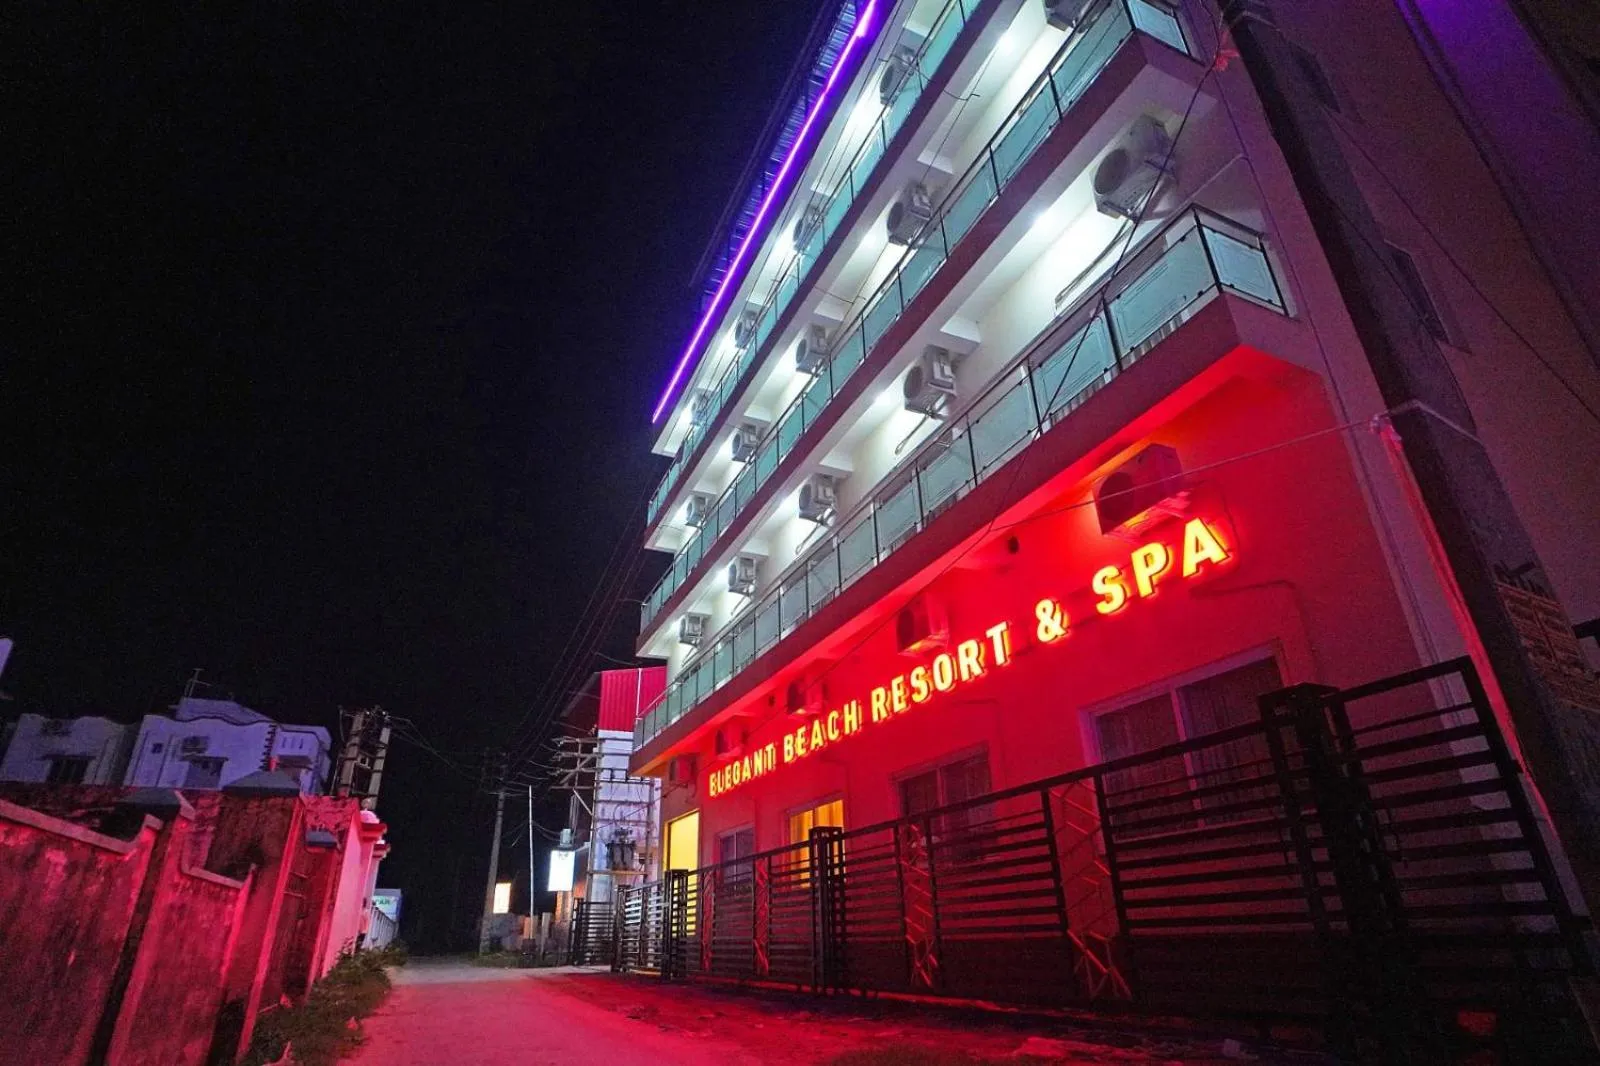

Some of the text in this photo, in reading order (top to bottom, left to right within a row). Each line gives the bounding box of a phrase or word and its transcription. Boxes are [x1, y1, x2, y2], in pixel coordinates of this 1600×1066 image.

[709, 517, 1230, 797] ELEGANT BEACH RESORT & SPA
